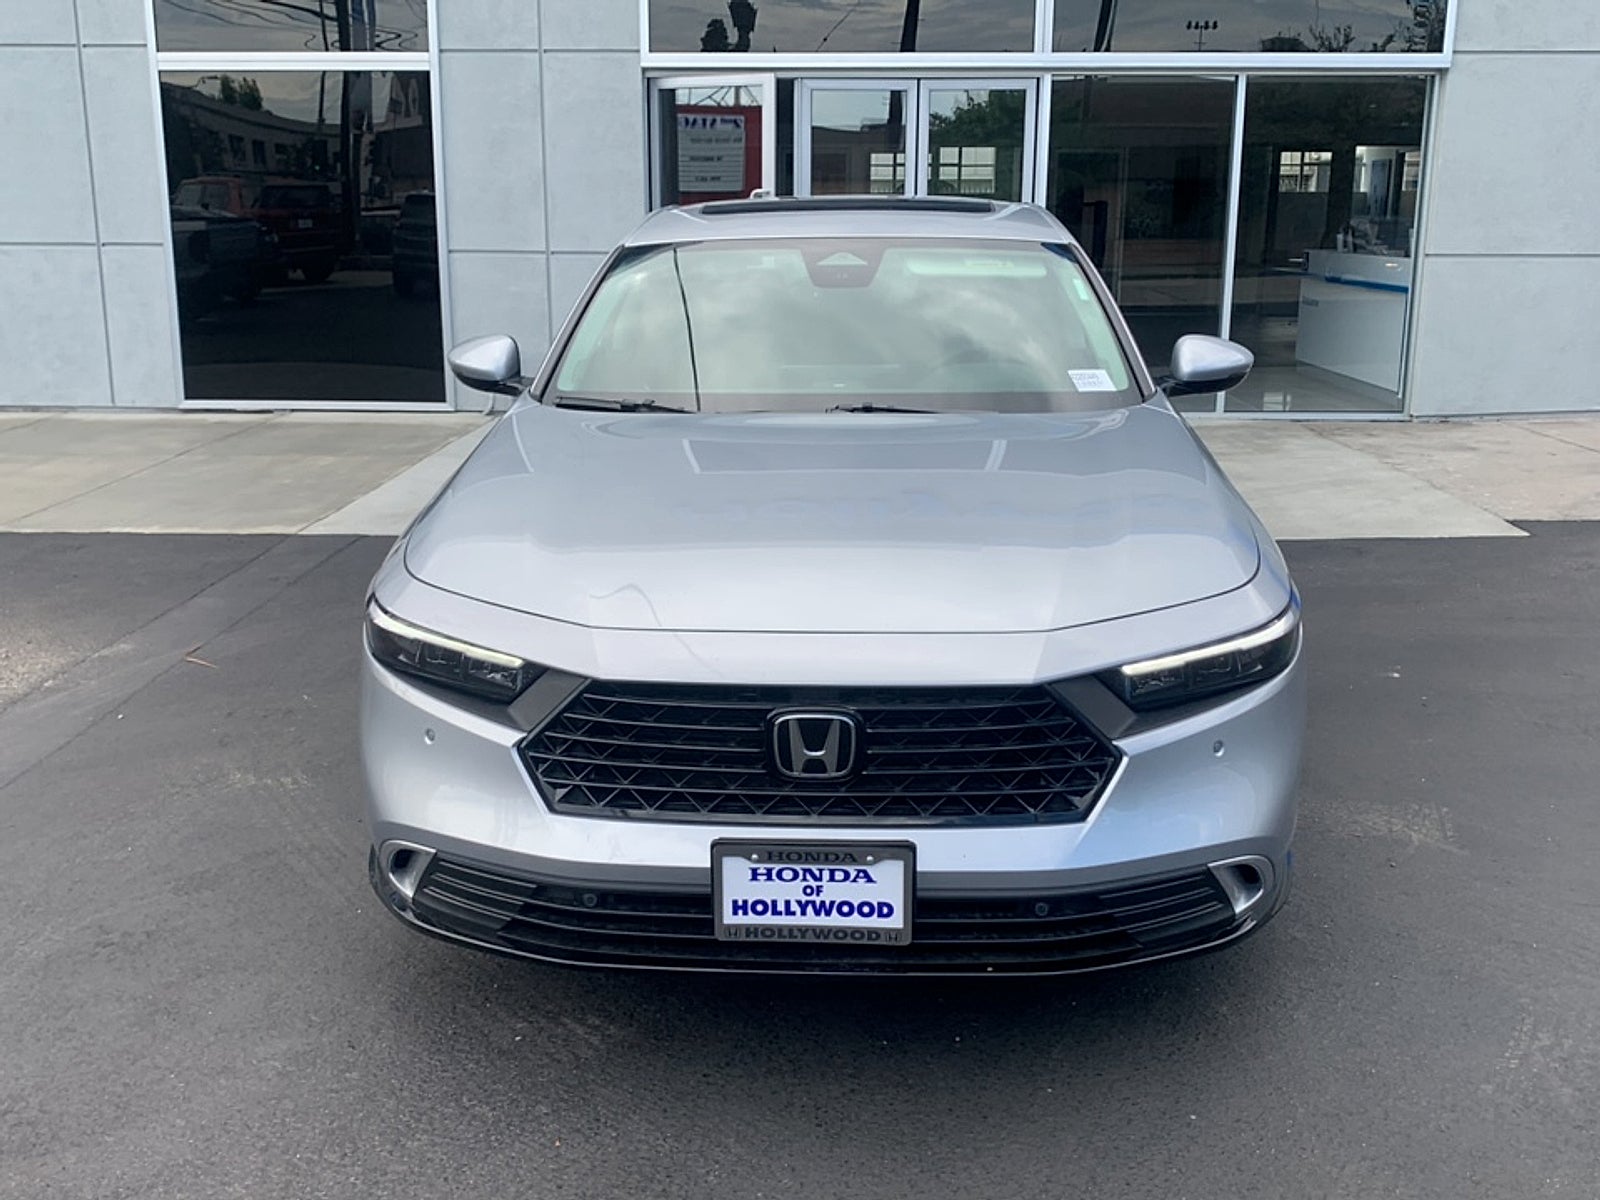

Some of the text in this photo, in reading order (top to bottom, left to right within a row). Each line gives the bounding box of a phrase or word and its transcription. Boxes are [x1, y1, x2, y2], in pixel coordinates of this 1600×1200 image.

[766, 851, 858, 863] HONDA
[749, 866, 877, 884] HONDA
[802, 884, 824, 897] OF
[731, 898, 895, 919] HOLLYWOOD
[744, 926, 881, 941] HOLLYWOOD
